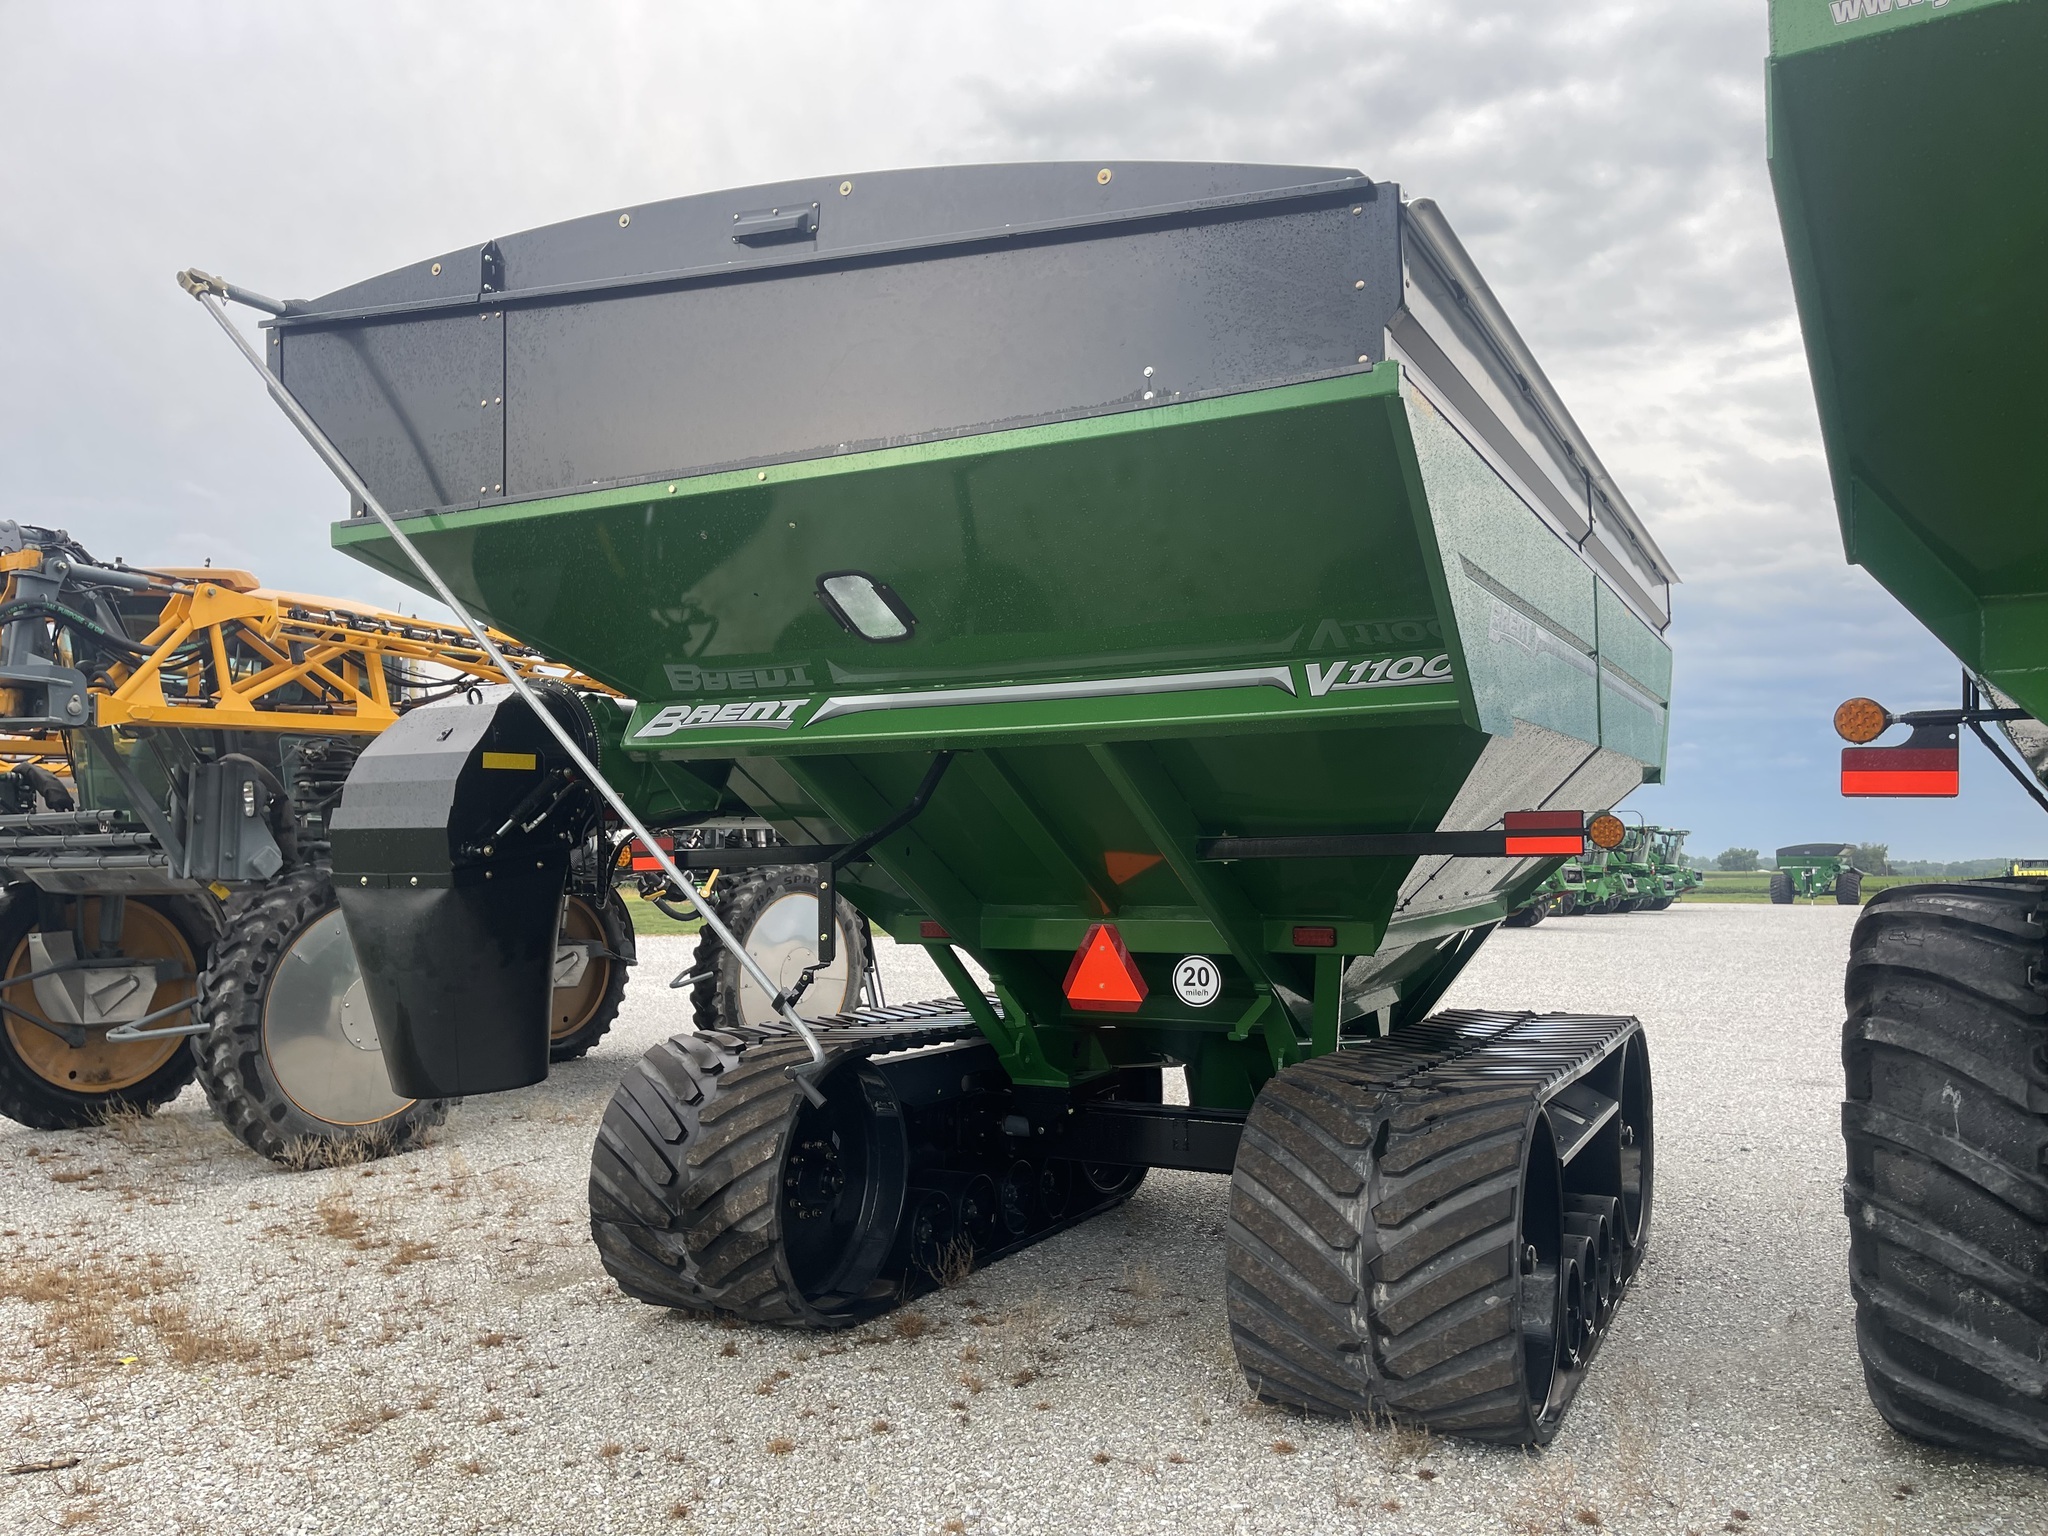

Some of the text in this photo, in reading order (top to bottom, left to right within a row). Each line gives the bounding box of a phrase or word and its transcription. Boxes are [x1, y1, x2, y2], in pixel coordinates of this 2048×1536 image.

[633, 699, 811, 737] BRENT
[1183, 966, 1210, 987] 20
[1185, 989, 1209, 997] mile/h
